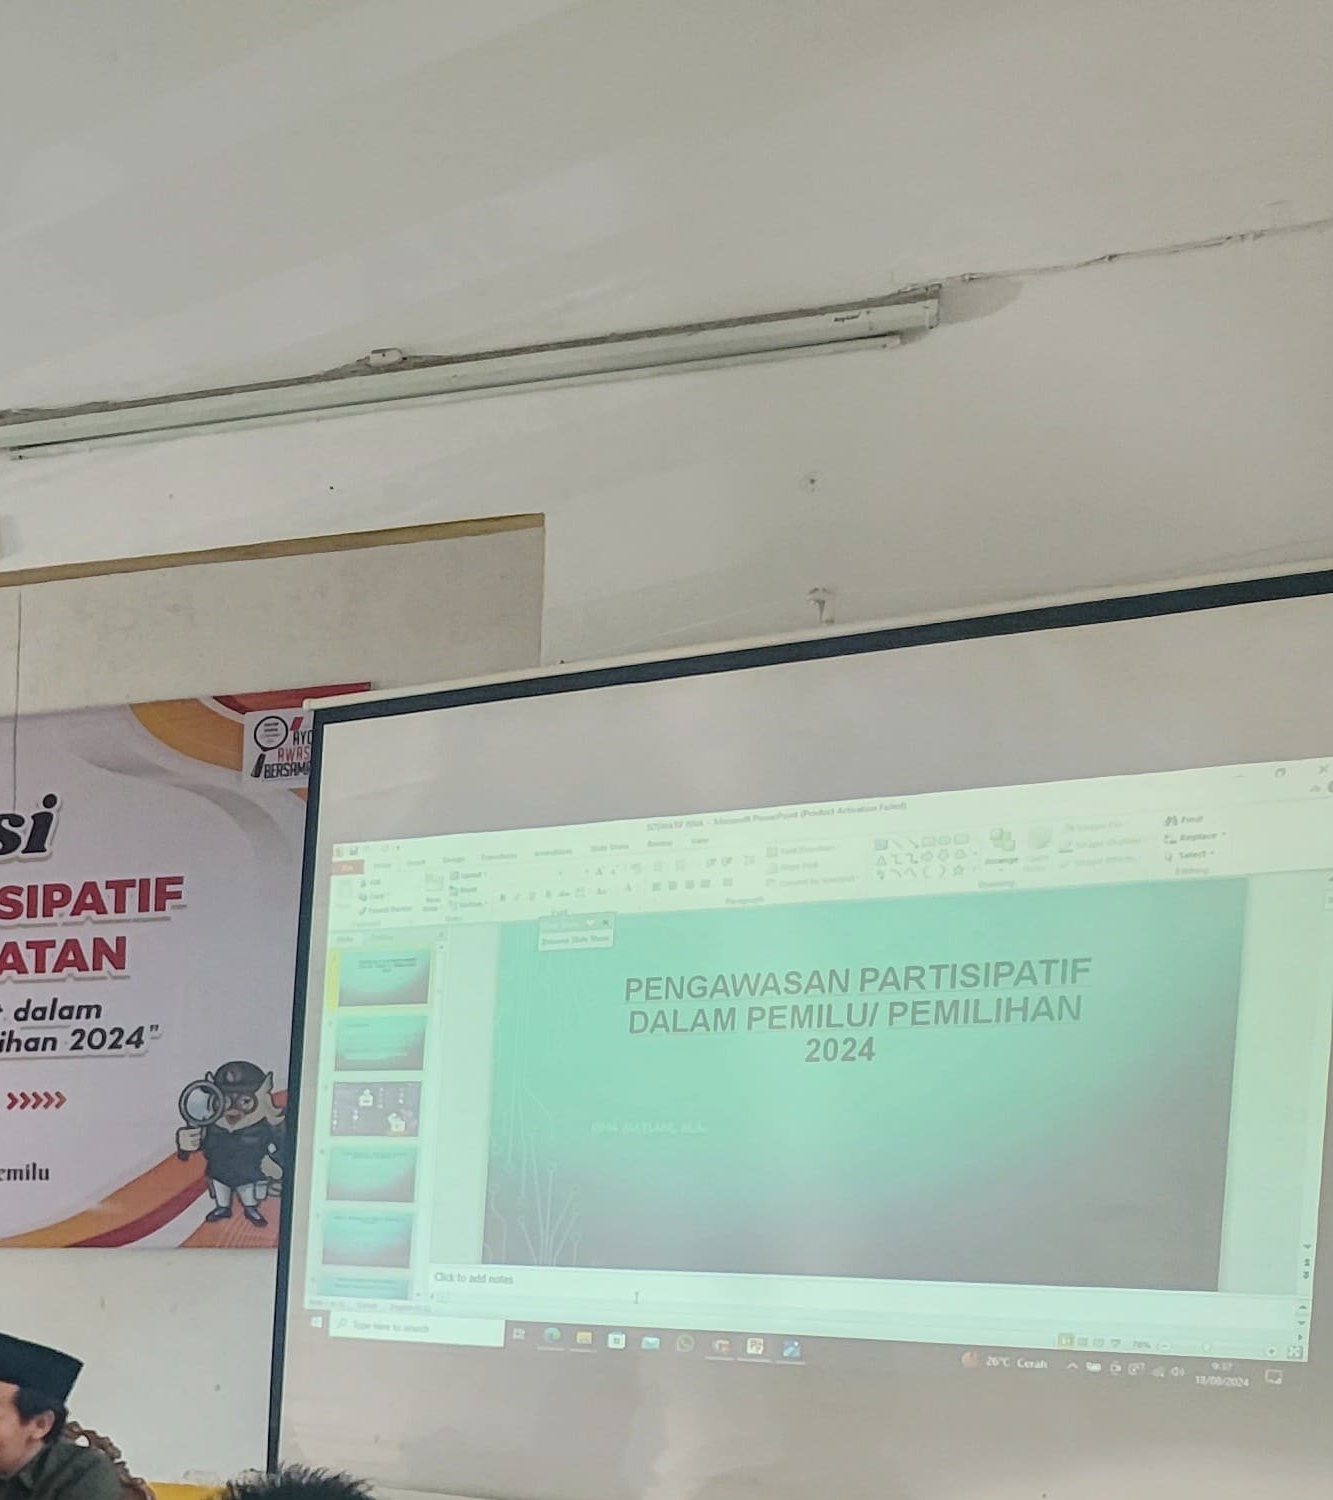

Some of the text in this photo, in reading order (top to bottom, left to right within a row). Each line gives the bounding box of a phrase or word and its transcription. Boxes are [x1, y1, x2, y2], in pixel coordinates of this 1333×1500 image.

[278, 745, 311, 761] AWAS
[624, 957, 1092, 1003] PENGAWASAN PARTISIPATIF
[13, 998, 103, 1021] dalam
[629, 994, 1083, 1036] DALAM PEMILU/ PEMILIHAN
[69, 1023, 159, 1051] 2024"
[805, 1037, 876, 1064] 2024
